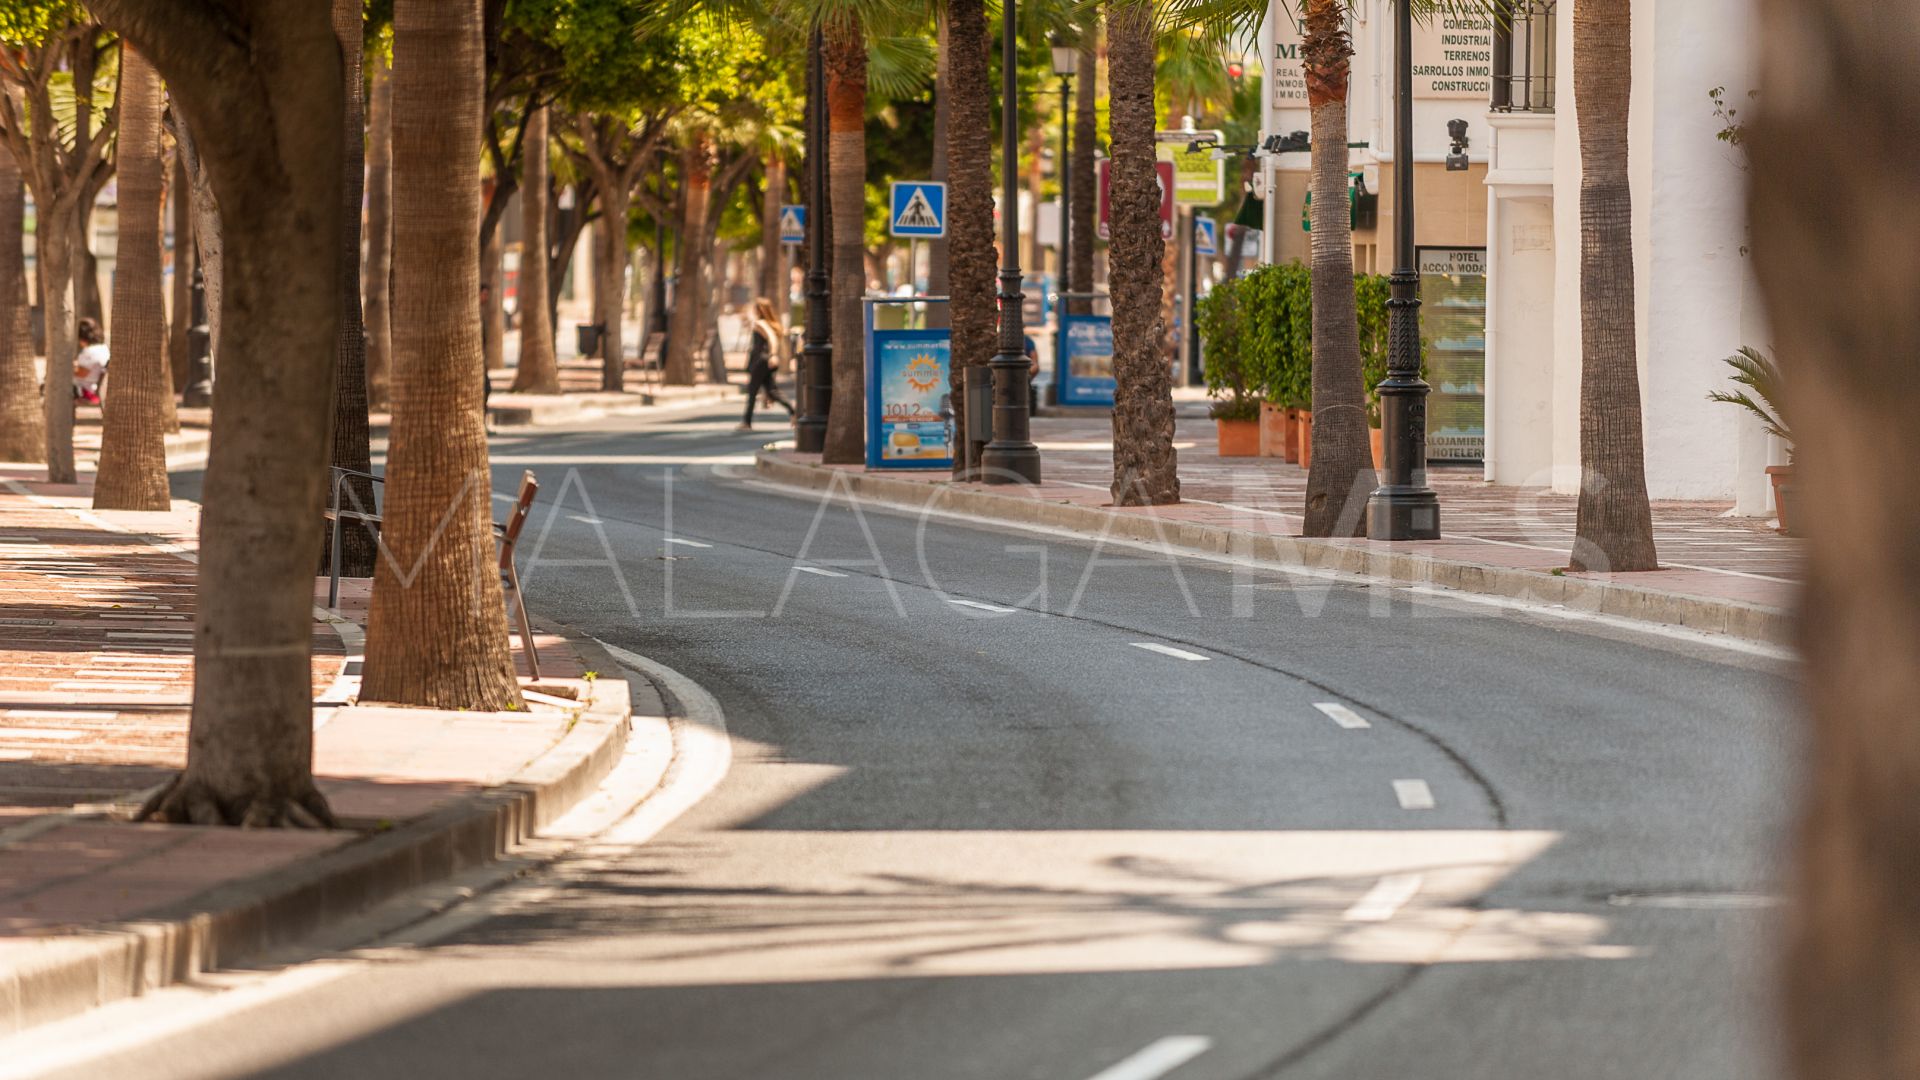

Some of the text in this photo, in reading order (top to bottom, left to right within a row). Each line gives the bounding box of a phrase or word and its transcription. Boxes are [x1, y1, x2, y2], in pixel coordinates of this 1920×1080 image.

[1444, 50, 1491, 62] TERRENOS
[1276, 68, 1299, 77] REAL
[1412, 65, 1491, 77] SARROLLOS INMO
[1275, 80, 1307, 88] INMOB
[1275, 91, 1308, 99] IMMOB
[1449, 252, 1480, 262] HOTEL
[1422, 263, 1486, 273] ACCOMMODA
[885, 402, 921, 416] 101.2
[1427, 436, 1485, 446] ALOJAMIEN
